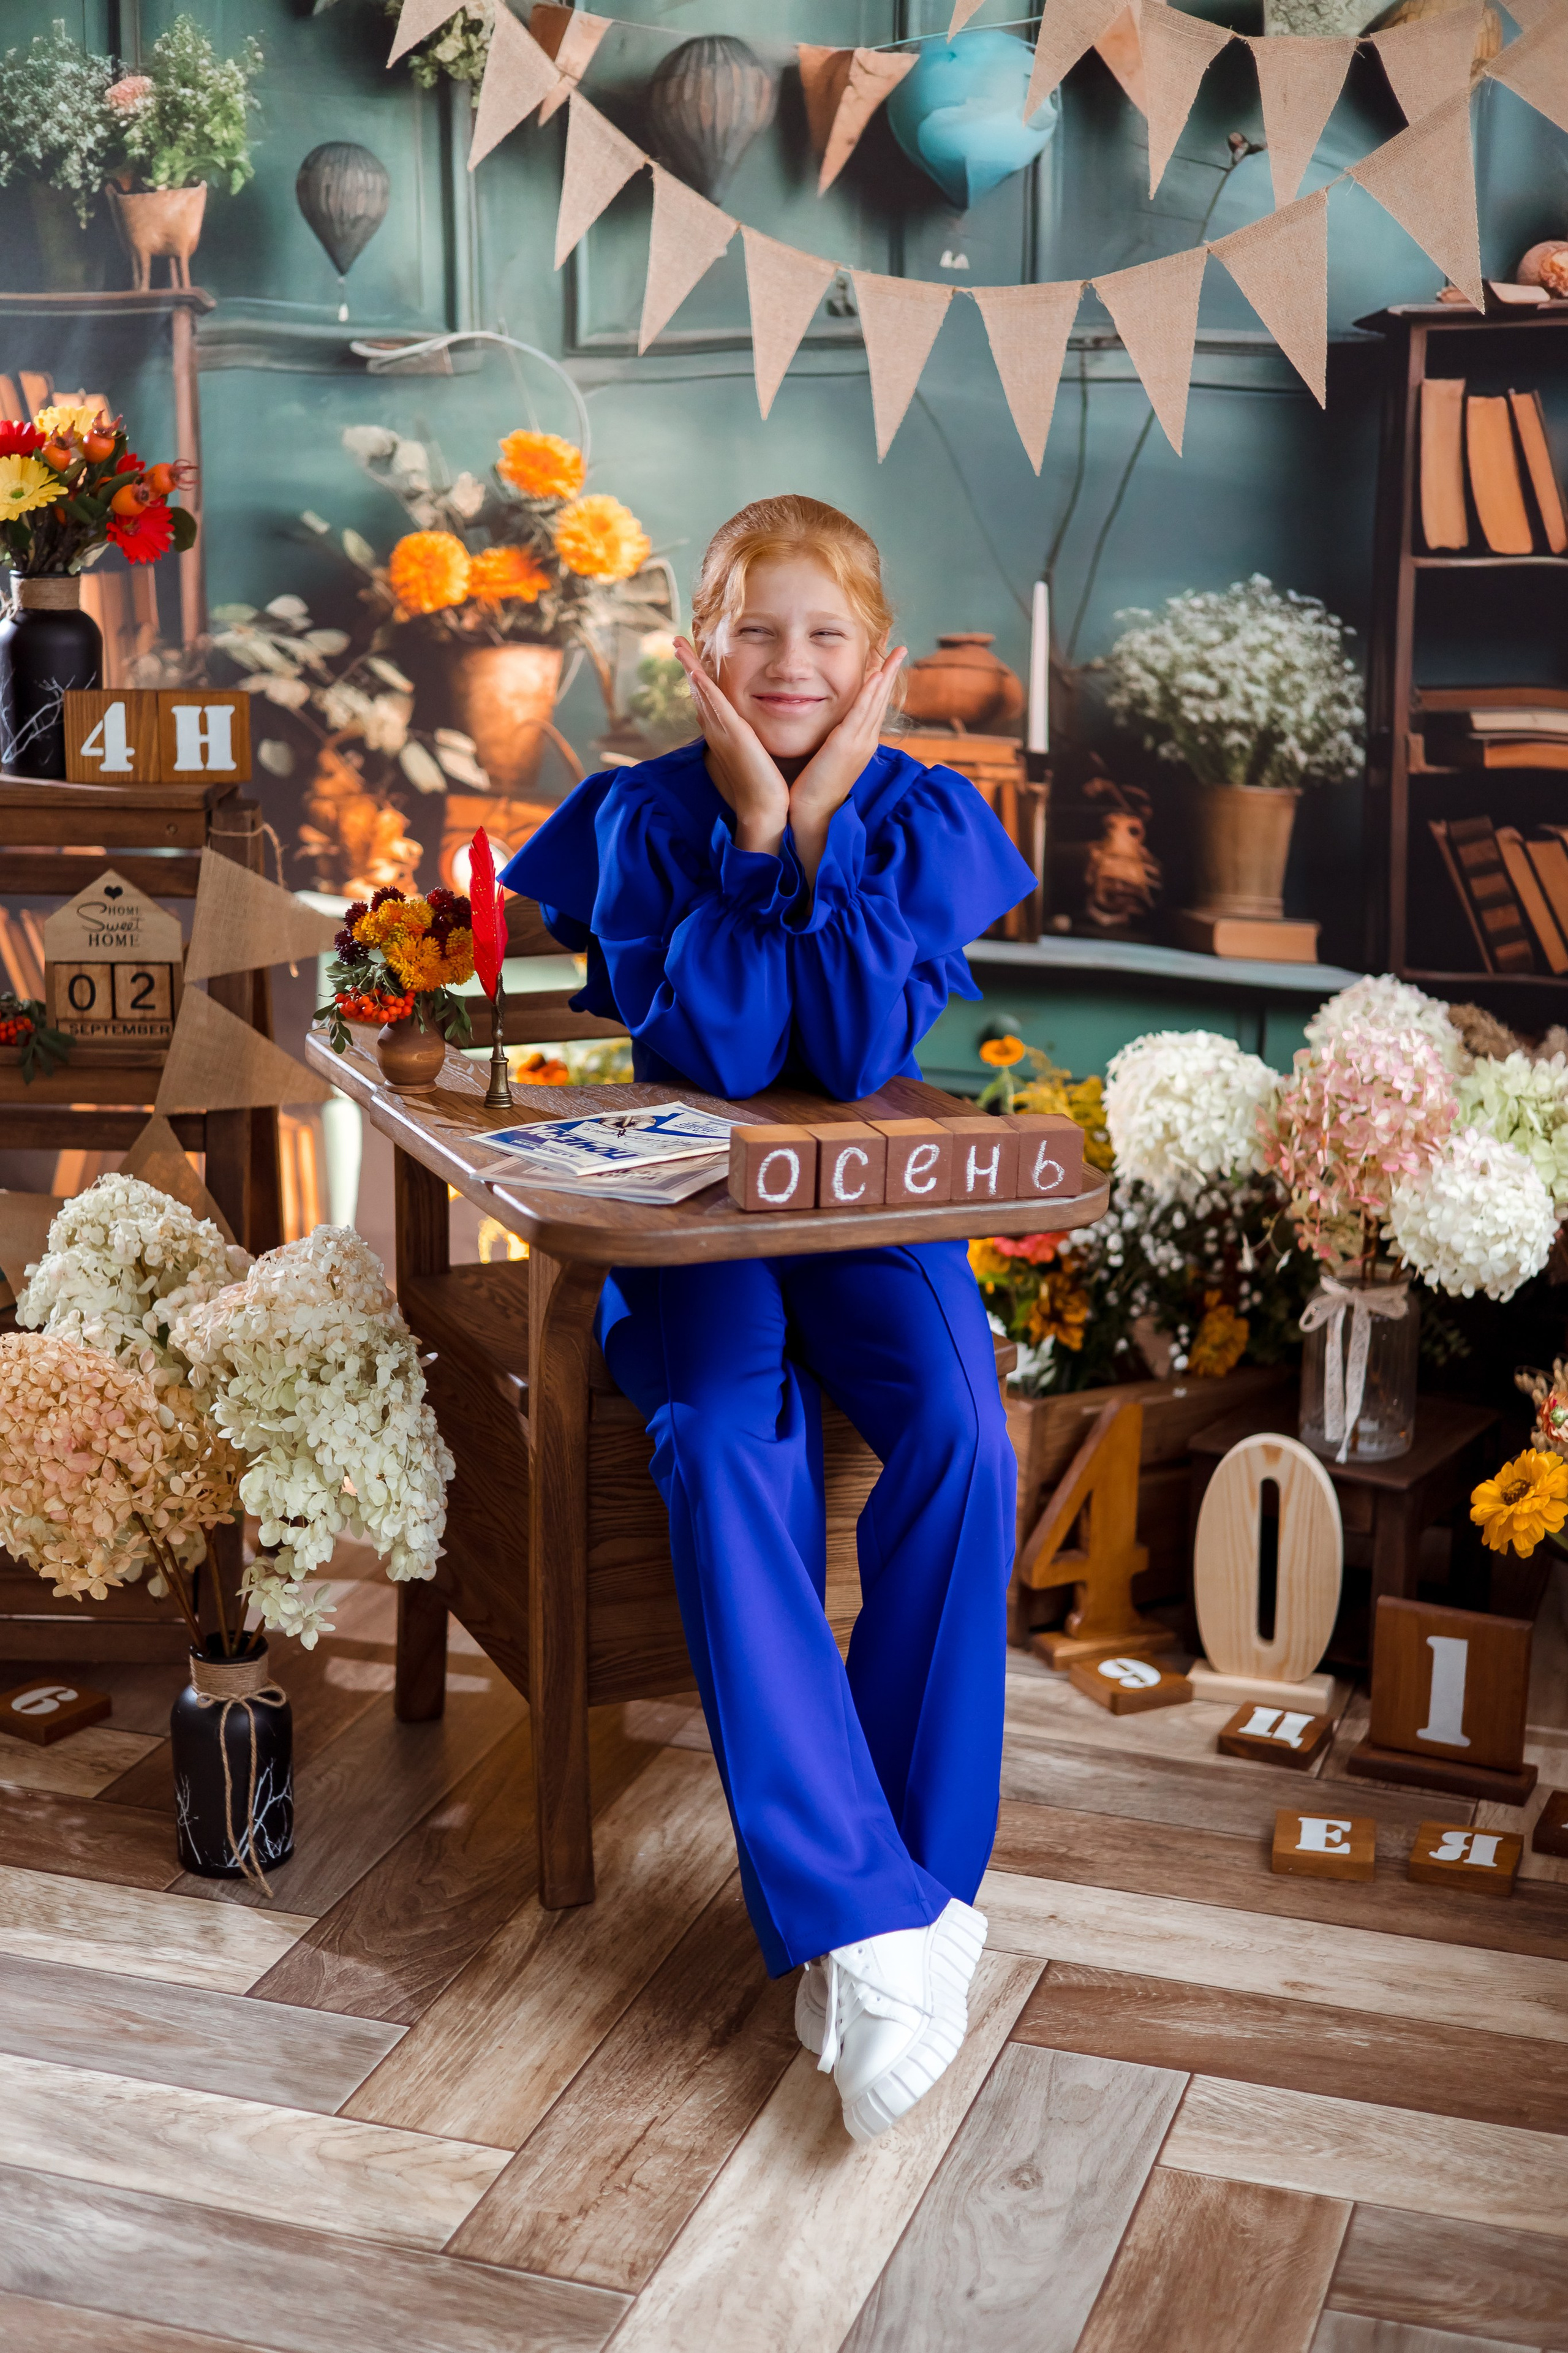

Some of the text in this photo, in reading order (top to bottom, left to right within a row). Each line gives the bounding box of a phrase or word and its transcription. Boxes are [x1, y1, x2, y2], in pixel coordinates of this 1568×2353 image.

[88, 933, 140, 948] HOME
[69, 1023, 171, 1036] SEPTEMBER
[517, 1125, 641, 1159] ПОЧЕРК
[1020, 1396, 1150, 1639] 4
[1416, 1636, 1471, 1747] 1
[1428, 1831, 1504, 1867] Я
